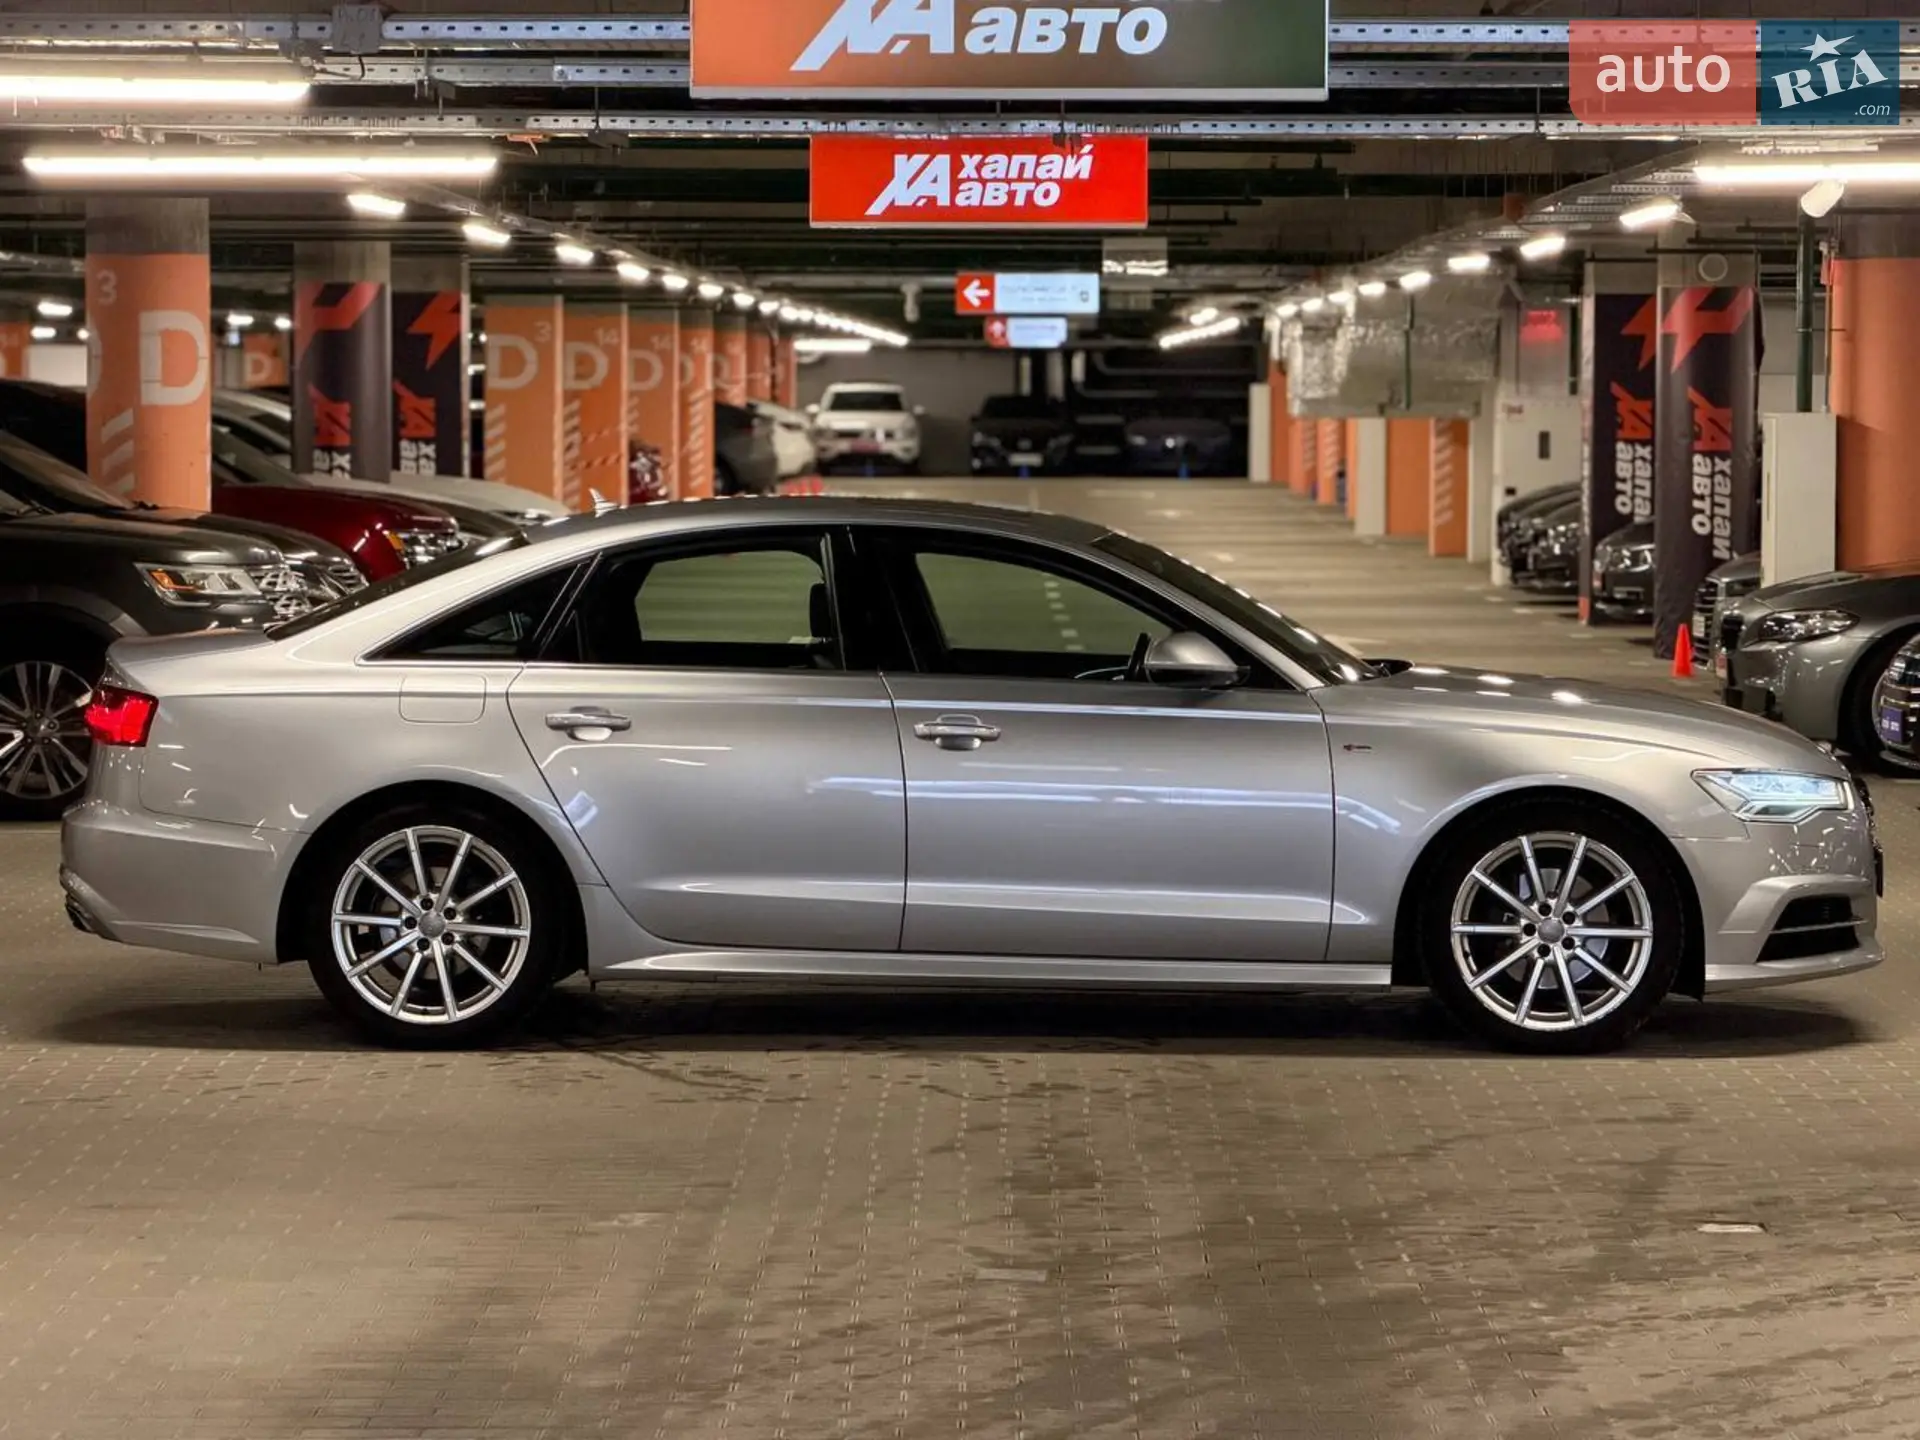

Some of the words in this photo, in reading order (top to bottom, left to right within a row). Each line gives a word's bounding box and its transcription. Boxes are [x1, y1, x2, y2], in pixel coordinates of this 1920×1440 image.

[964, 7, 1168, 55] авто
[957, 145, 1094, 180] хапай
[955, 181, 1061, 208] авто
[97, 269, 118, 305] 3
[139, 309, 209, 406] D
[486, 333, 539, 390] D
[534, 320, 551, 343] 3
[562, 340, 610, 391] D
[627, 348, 664, 391] D
[1614, 441, 1634, 515] авто
[1691, 453, 1712, 536] авто
